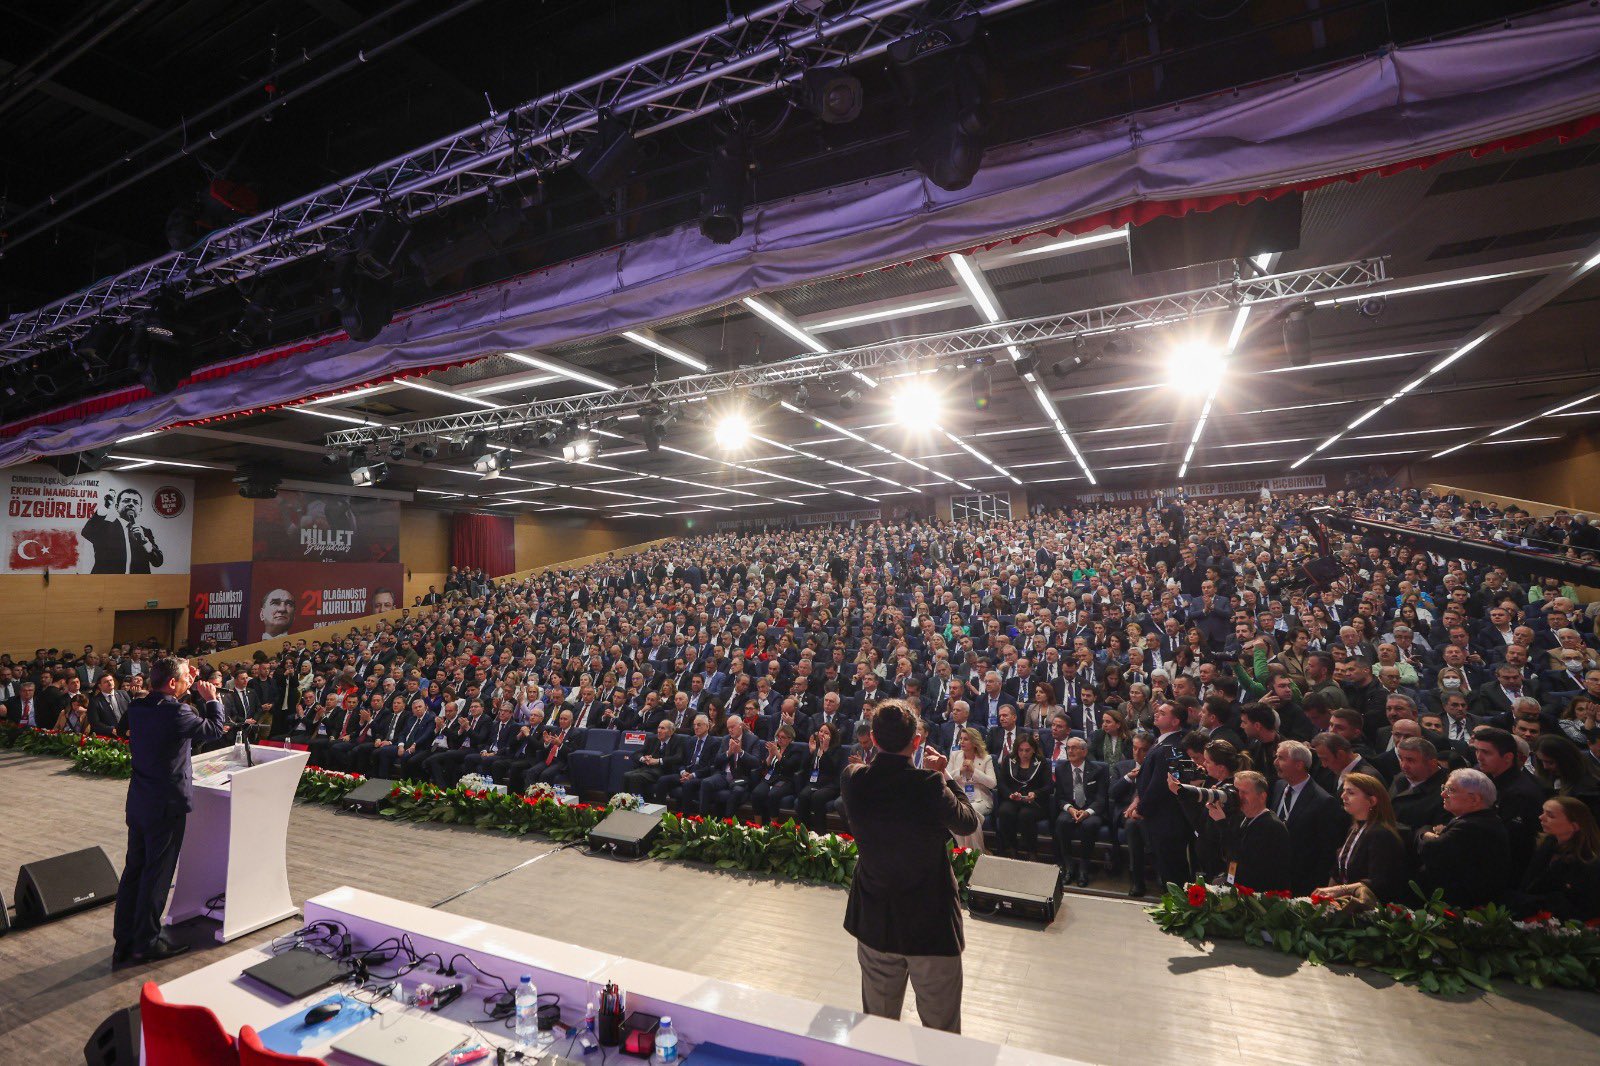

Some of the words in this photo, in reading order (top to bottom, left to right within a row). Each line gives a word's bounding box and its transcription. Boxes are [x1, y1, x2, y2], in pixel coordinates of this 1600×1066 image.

[10, 486, 41, 496] EKREM
[43, 486, 98, 498] İMAMOĞLU'NA
[8, 496, 98, 518] ÖZGÜRLÜK
[300, 524, 354, 545] MİLLET
[209, 589, 243, 603] OLAĞANÜSTÜ
[323, 587, 367, 600] OLAĞANÜSTÜ
[208, 604, 242, 619] KURULTAY
[322, 600, 367, 615] KURULTAY
